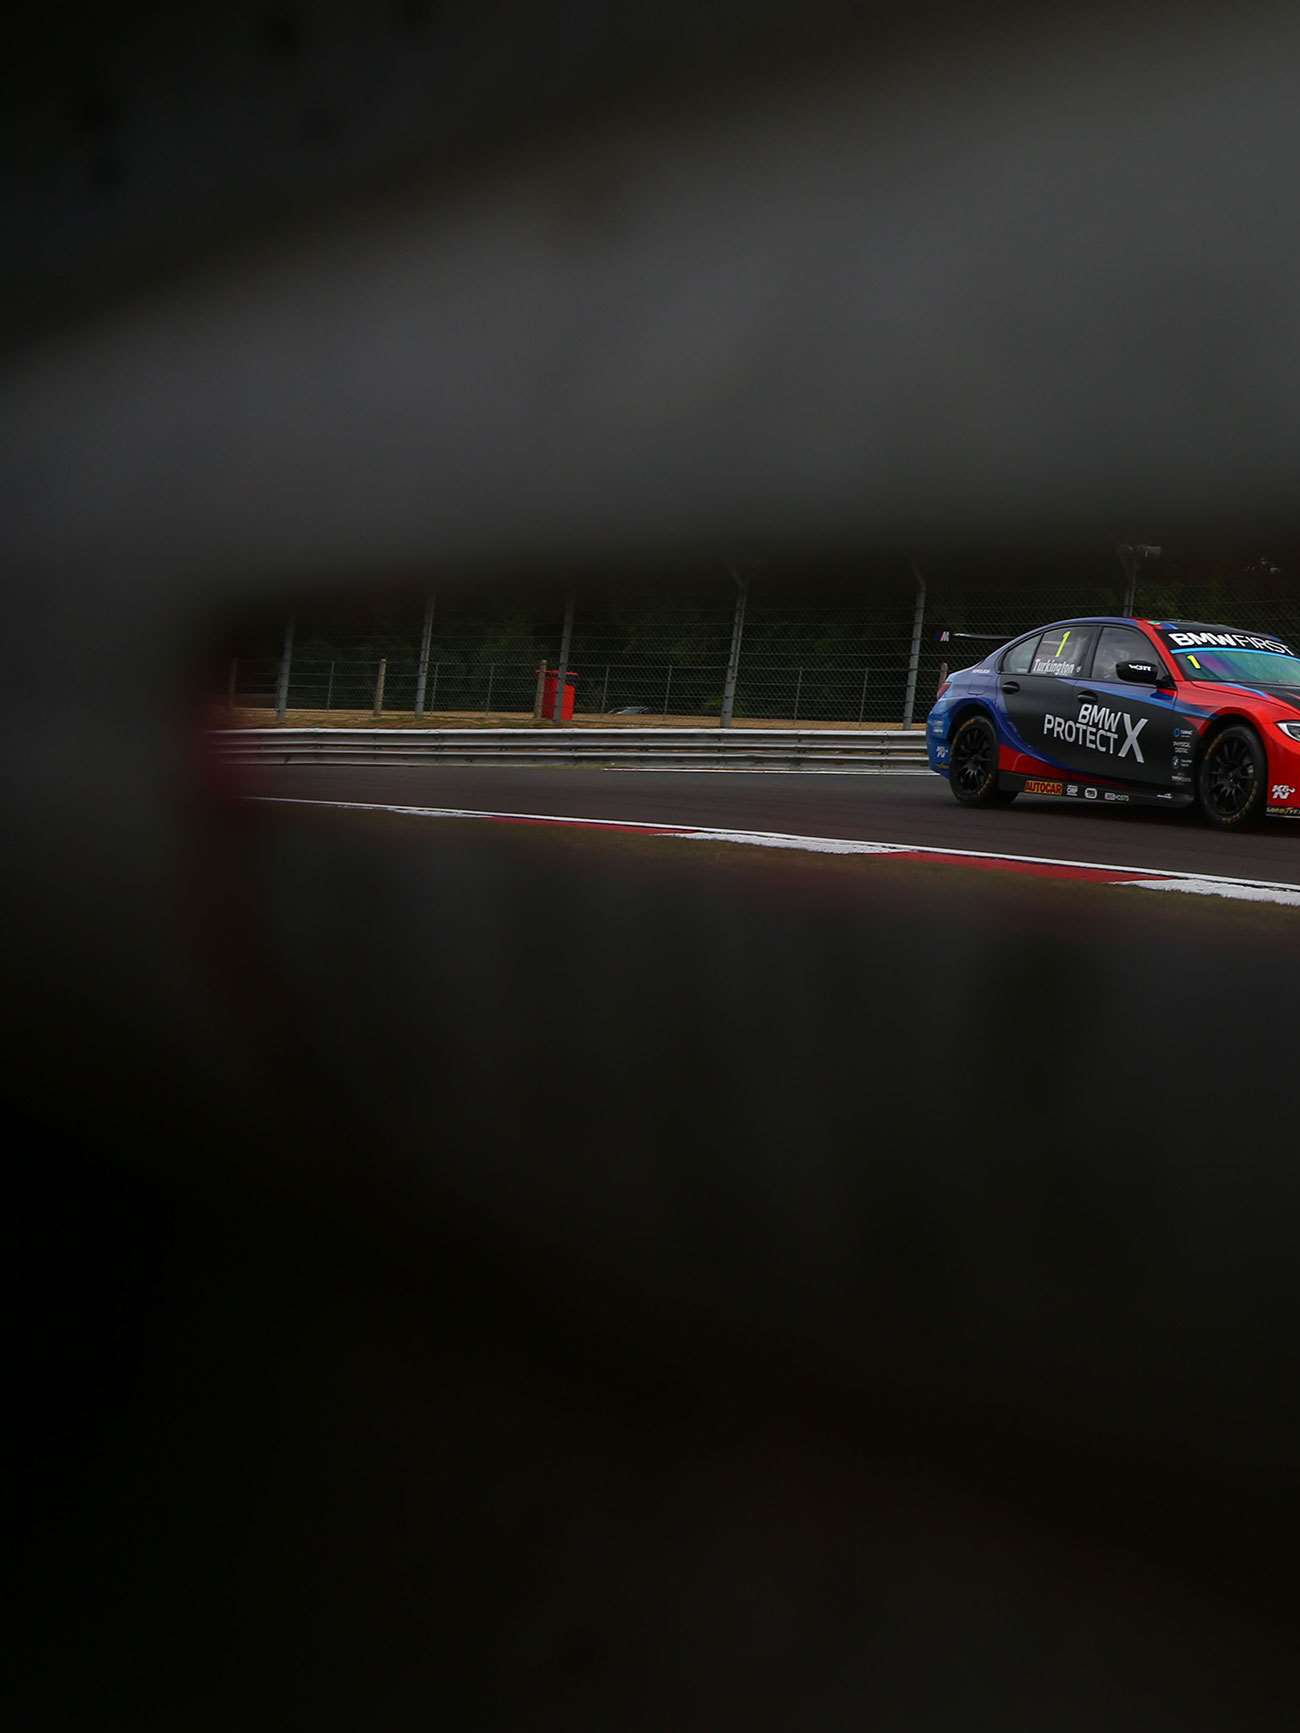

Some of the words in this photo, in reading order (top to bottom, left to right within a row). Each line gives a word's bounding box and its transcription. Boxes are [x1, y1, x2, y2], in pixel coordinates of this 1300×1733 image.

[1055, 631, 1071, 657] 1
[1033, 659, 1075, 675] Turkington
[1187, 655, 1200, 669] 1
[1078, 703, 1122, 732] BMW
[1043, 713, 1118, 754] PROTECT
[1117, 712, 1149, 763] X
[1025, 780, 1063, 795] AUTOCAR
